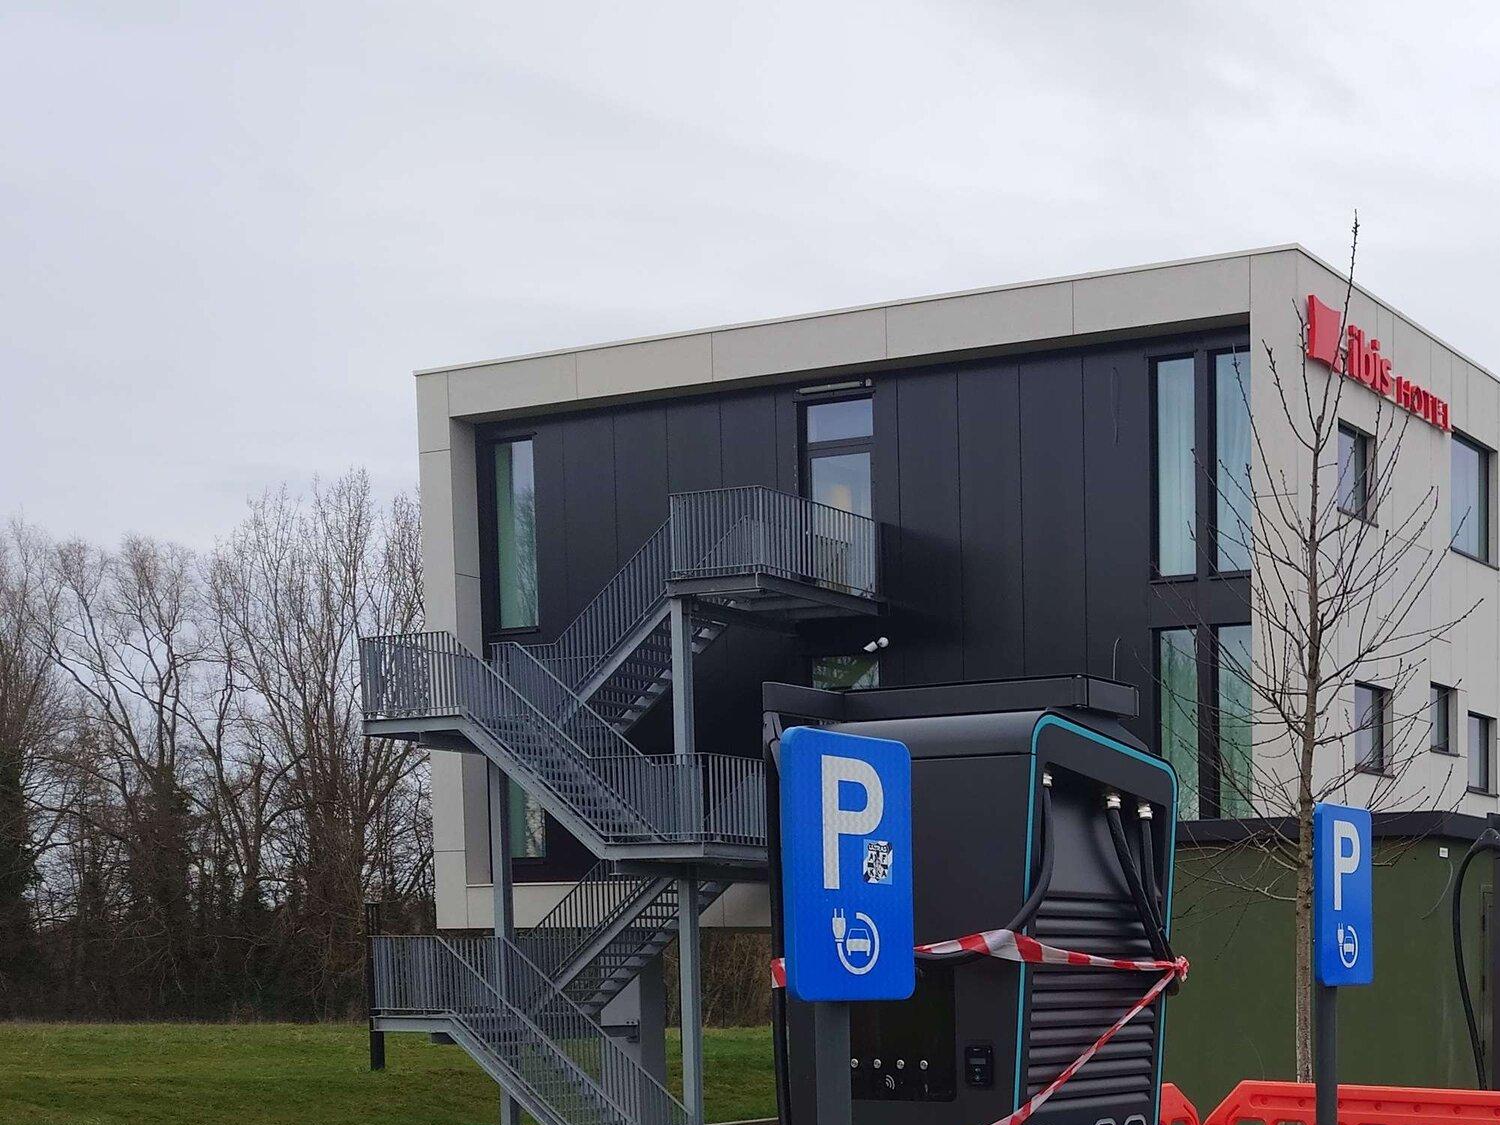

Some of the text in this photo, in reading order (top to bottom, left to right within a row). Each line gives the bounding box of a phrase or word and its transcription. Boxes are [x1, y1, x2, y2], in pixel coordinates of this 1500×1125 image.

[1347, 325, 1449, 432] ibis HOTEL
[822, 754, 884, 890] P
[1333, 820, 1361, 911] P
